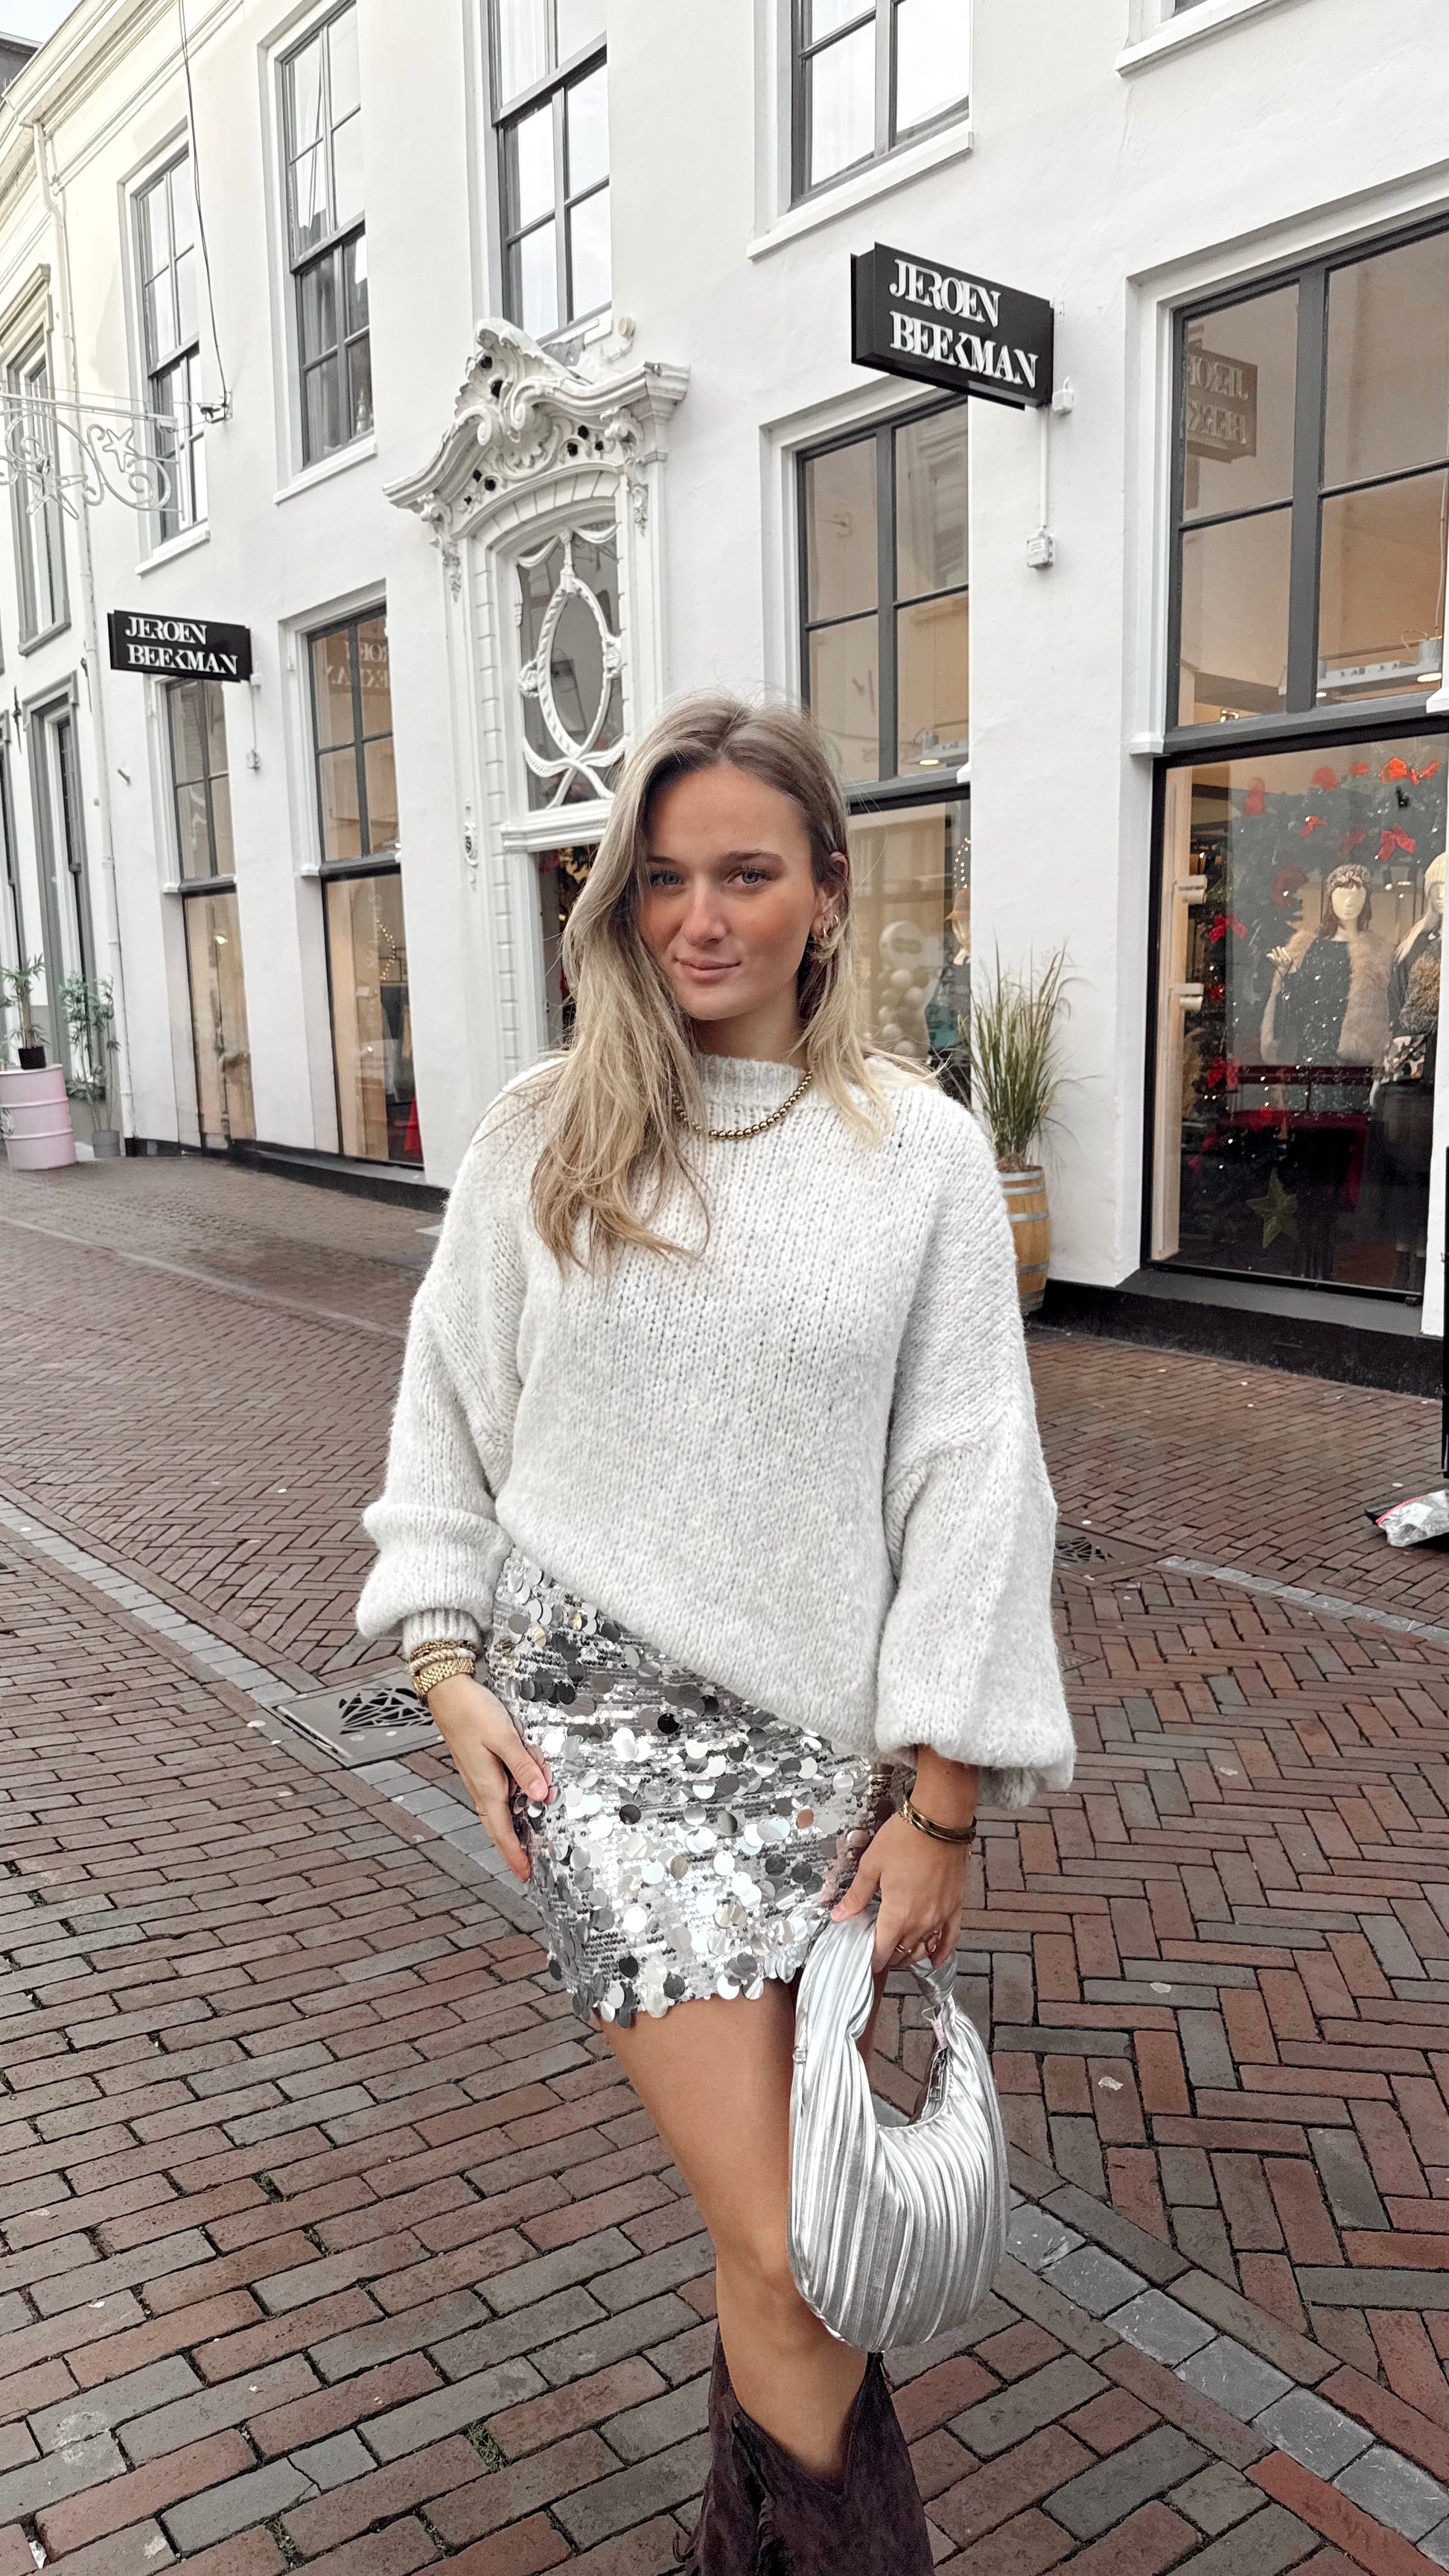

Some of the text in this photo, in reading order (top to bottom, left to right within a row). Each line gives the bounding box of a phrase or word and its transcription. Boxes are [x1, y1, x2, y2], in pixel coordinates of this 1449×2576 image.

[889, 258, 1001, 328] JEROEN
[889, 310, 1039, 389] BEEKMAN
[125, 616, 208, 645] JEROEN
[126, 643, 238, 675] BEEKMAN
